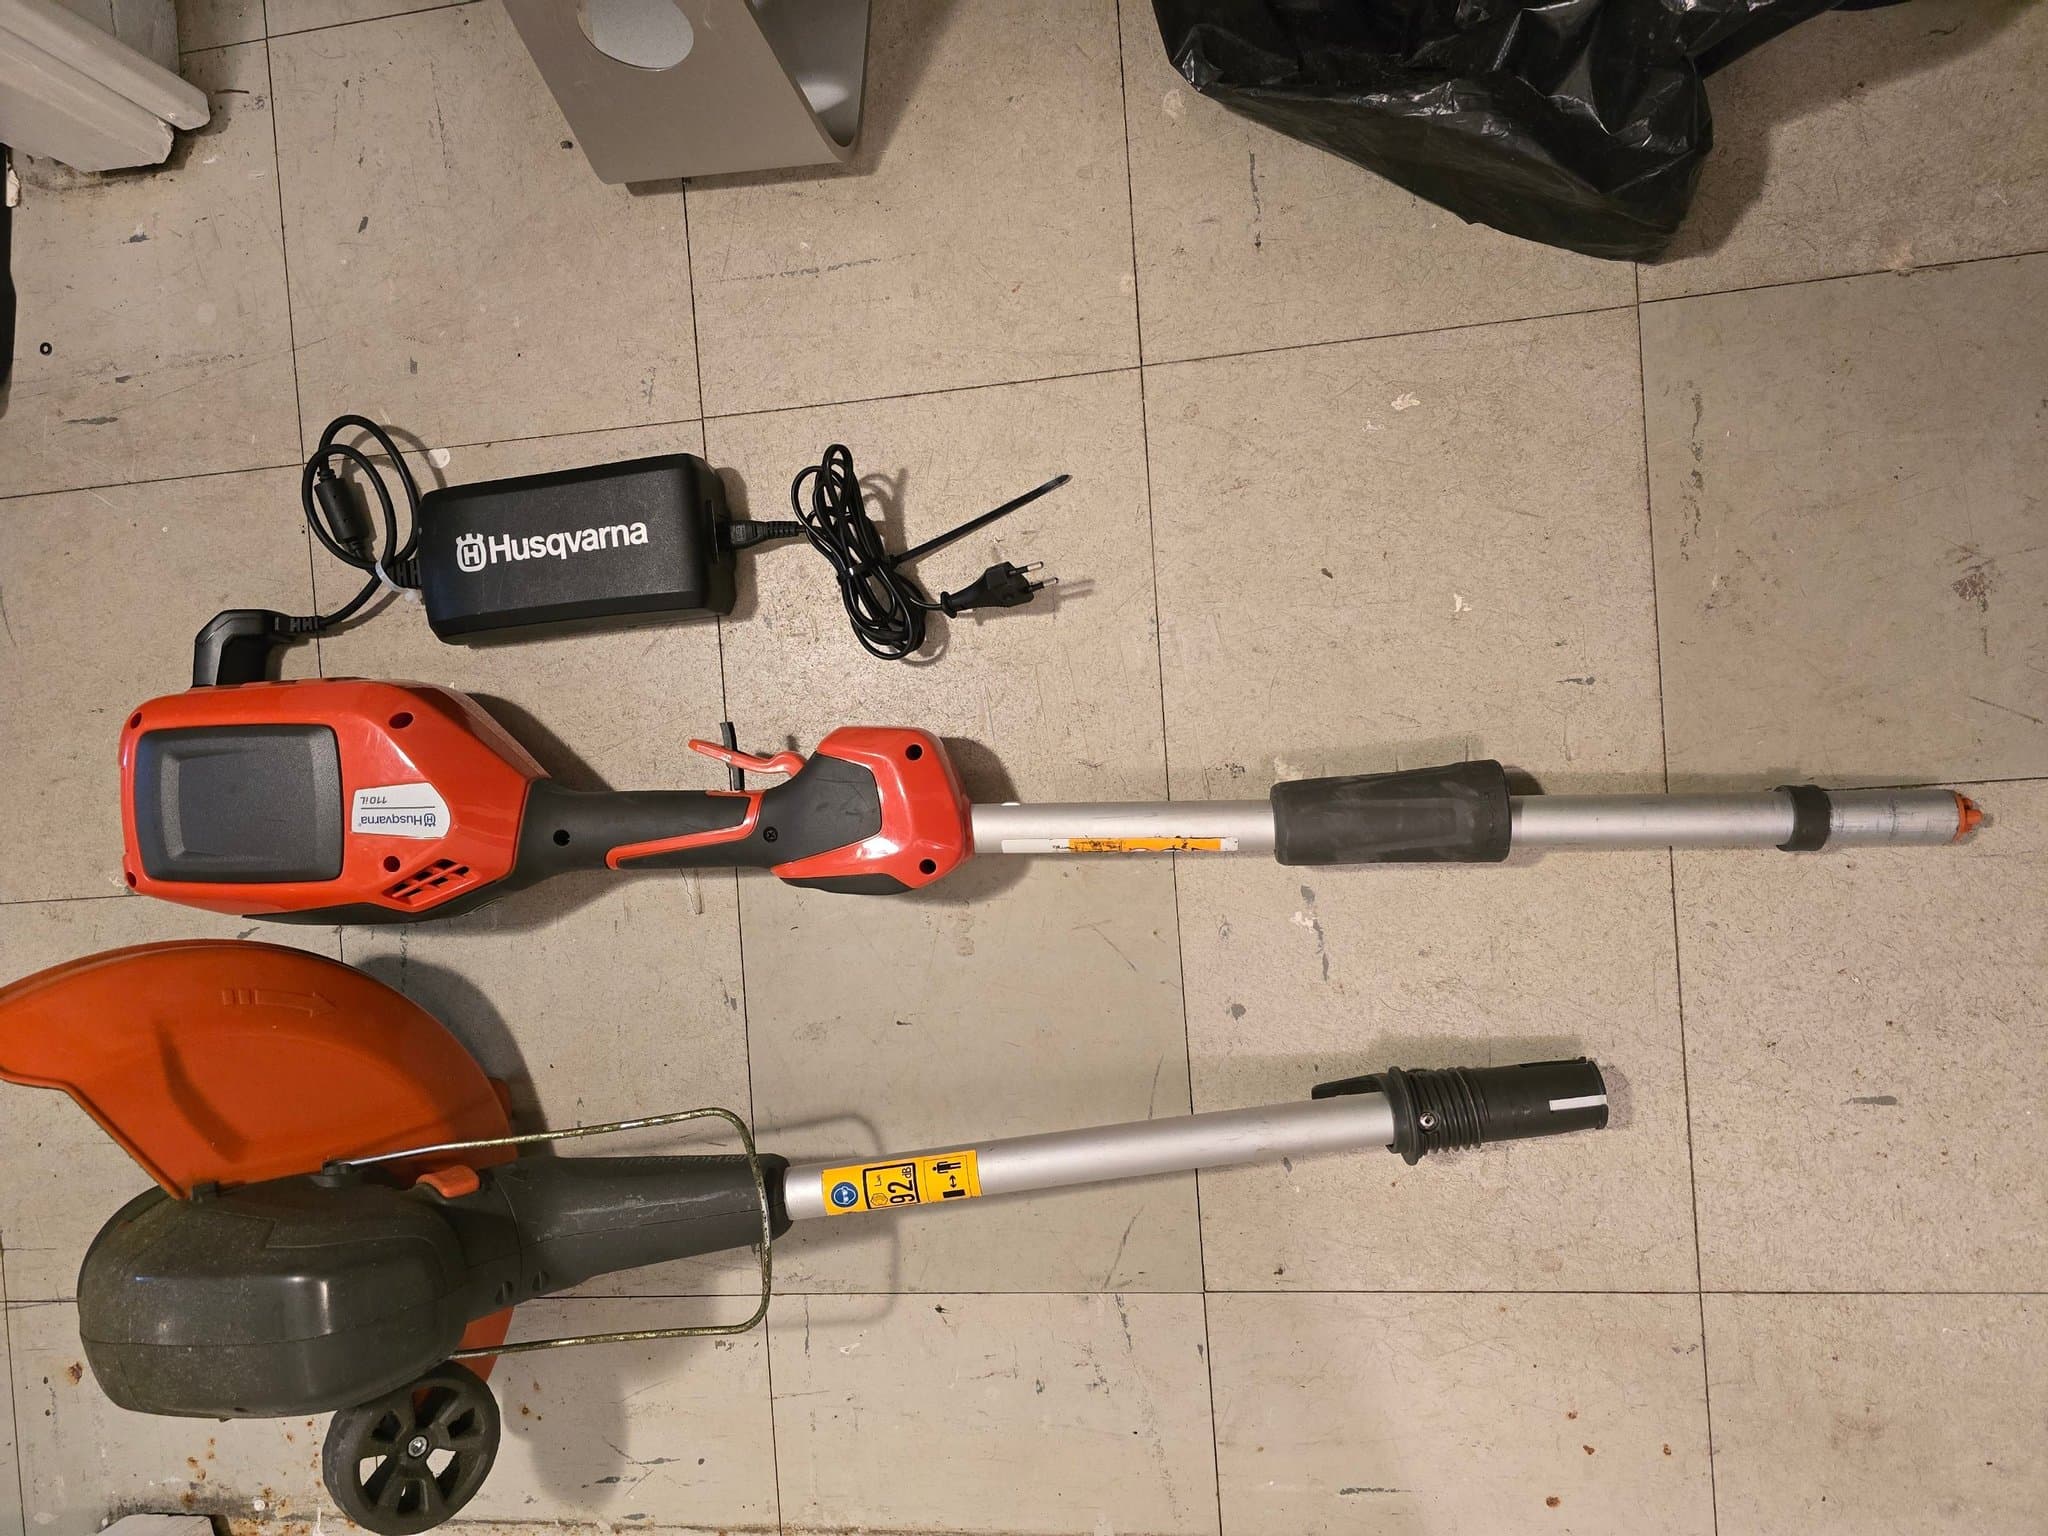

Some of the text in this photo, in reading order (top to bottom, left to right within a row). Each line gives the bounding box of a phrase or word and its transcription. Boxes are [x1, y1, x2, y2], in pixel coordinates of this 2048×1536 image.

[487, 521, 649, 564] Husqvarna
[361, 813, 423, 826] Husqvarna
[887, 1166, 915, 1204] 92 dB
